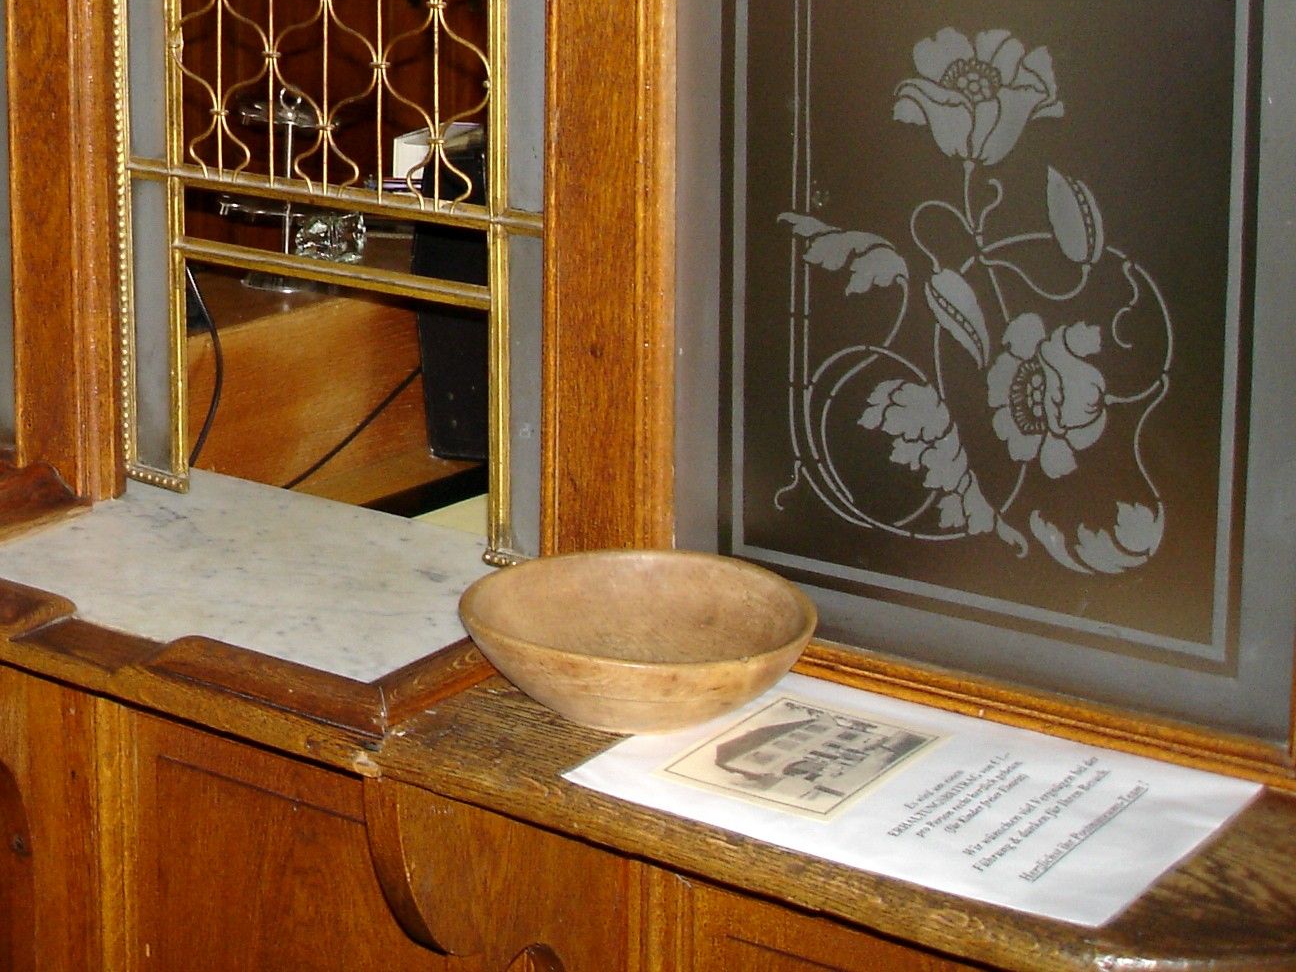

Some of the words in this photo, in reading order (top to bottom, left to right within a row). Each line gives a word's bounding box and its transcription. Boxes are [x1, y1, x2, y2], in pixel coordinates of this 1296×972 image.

[926, 808, 954, 828] Person
[956, 804, 984, 823] Kinder
[978, 812, 1022, 845] wünschen
[1017, 800, 1037, 816] viel
[1029, 772, 1077, 808] Vergnügen
[972, 840, 1016, 873] Führung
